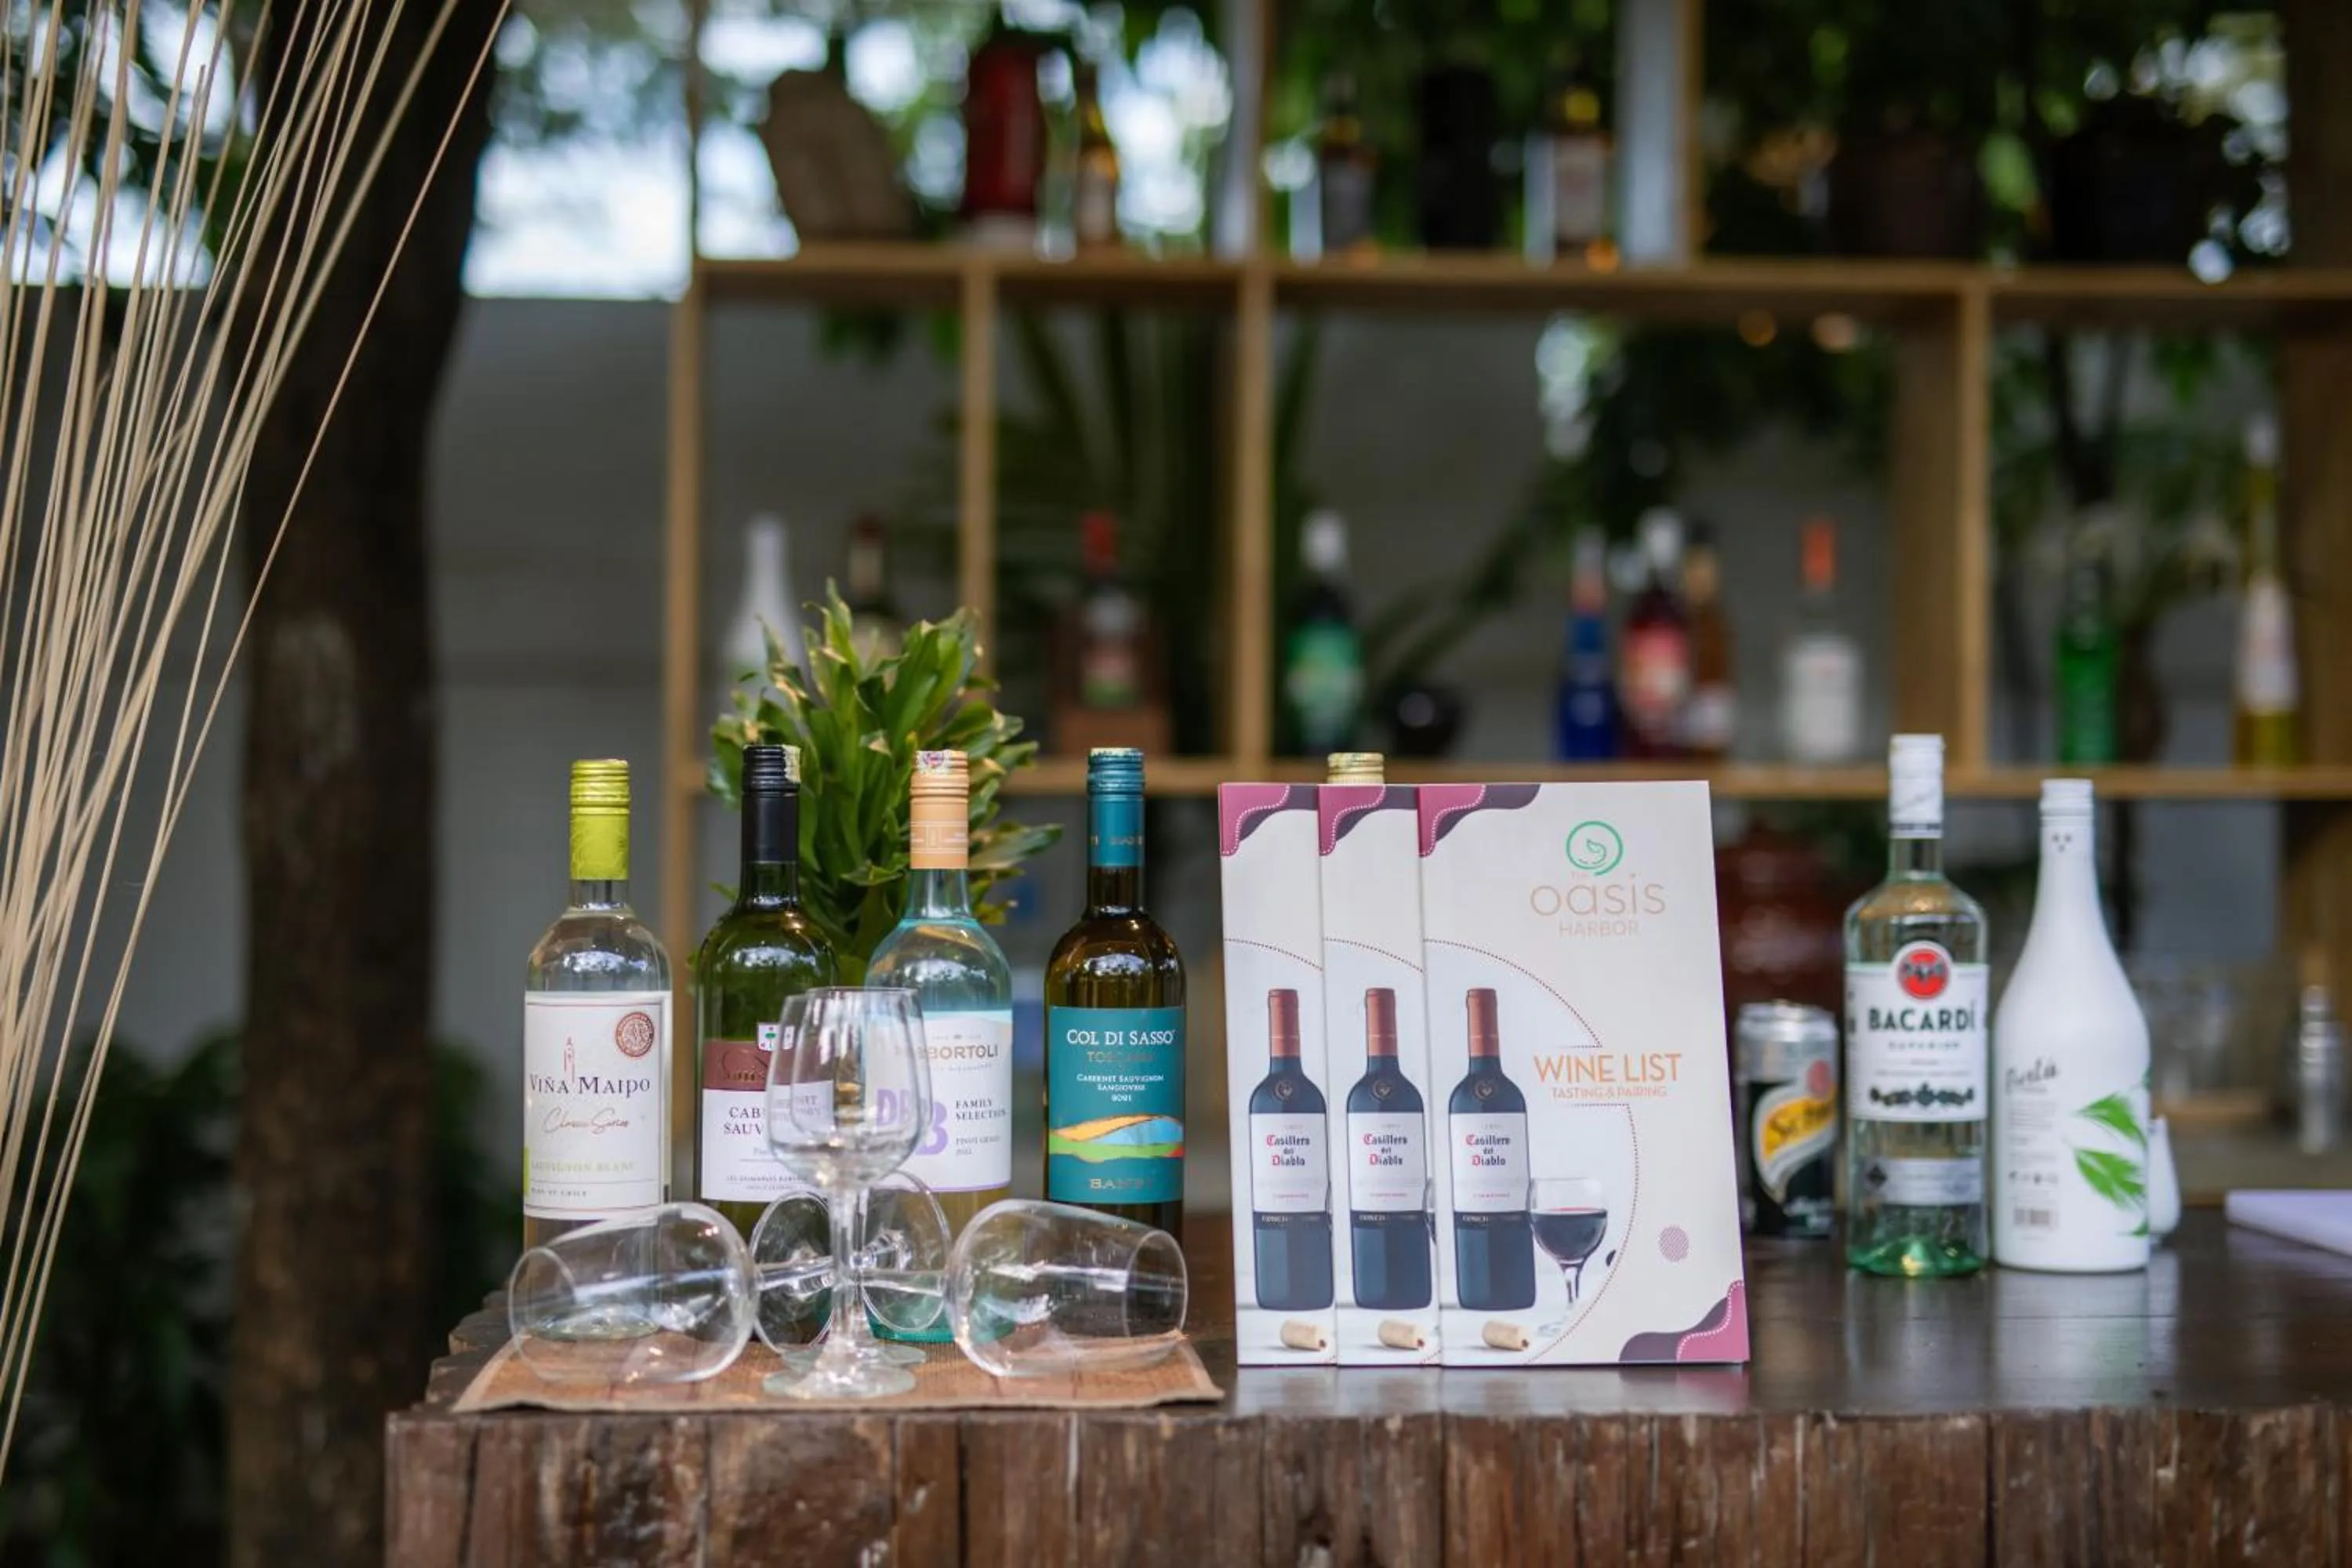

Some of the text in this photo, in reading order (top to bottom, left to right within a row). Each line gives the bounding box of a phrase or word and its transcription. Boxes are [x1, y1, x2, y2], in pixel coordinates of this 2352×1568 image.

[1559, 919, 1639, 937] HARBOR
[1066, 1029, 1174, 1045] COL DI SASSO
[1534, 1053, 1682, 1083] WINE LIST
[529, 1074, 570, 1094] VIÑA
[955, 1098, 993, 1109] FAMILY
